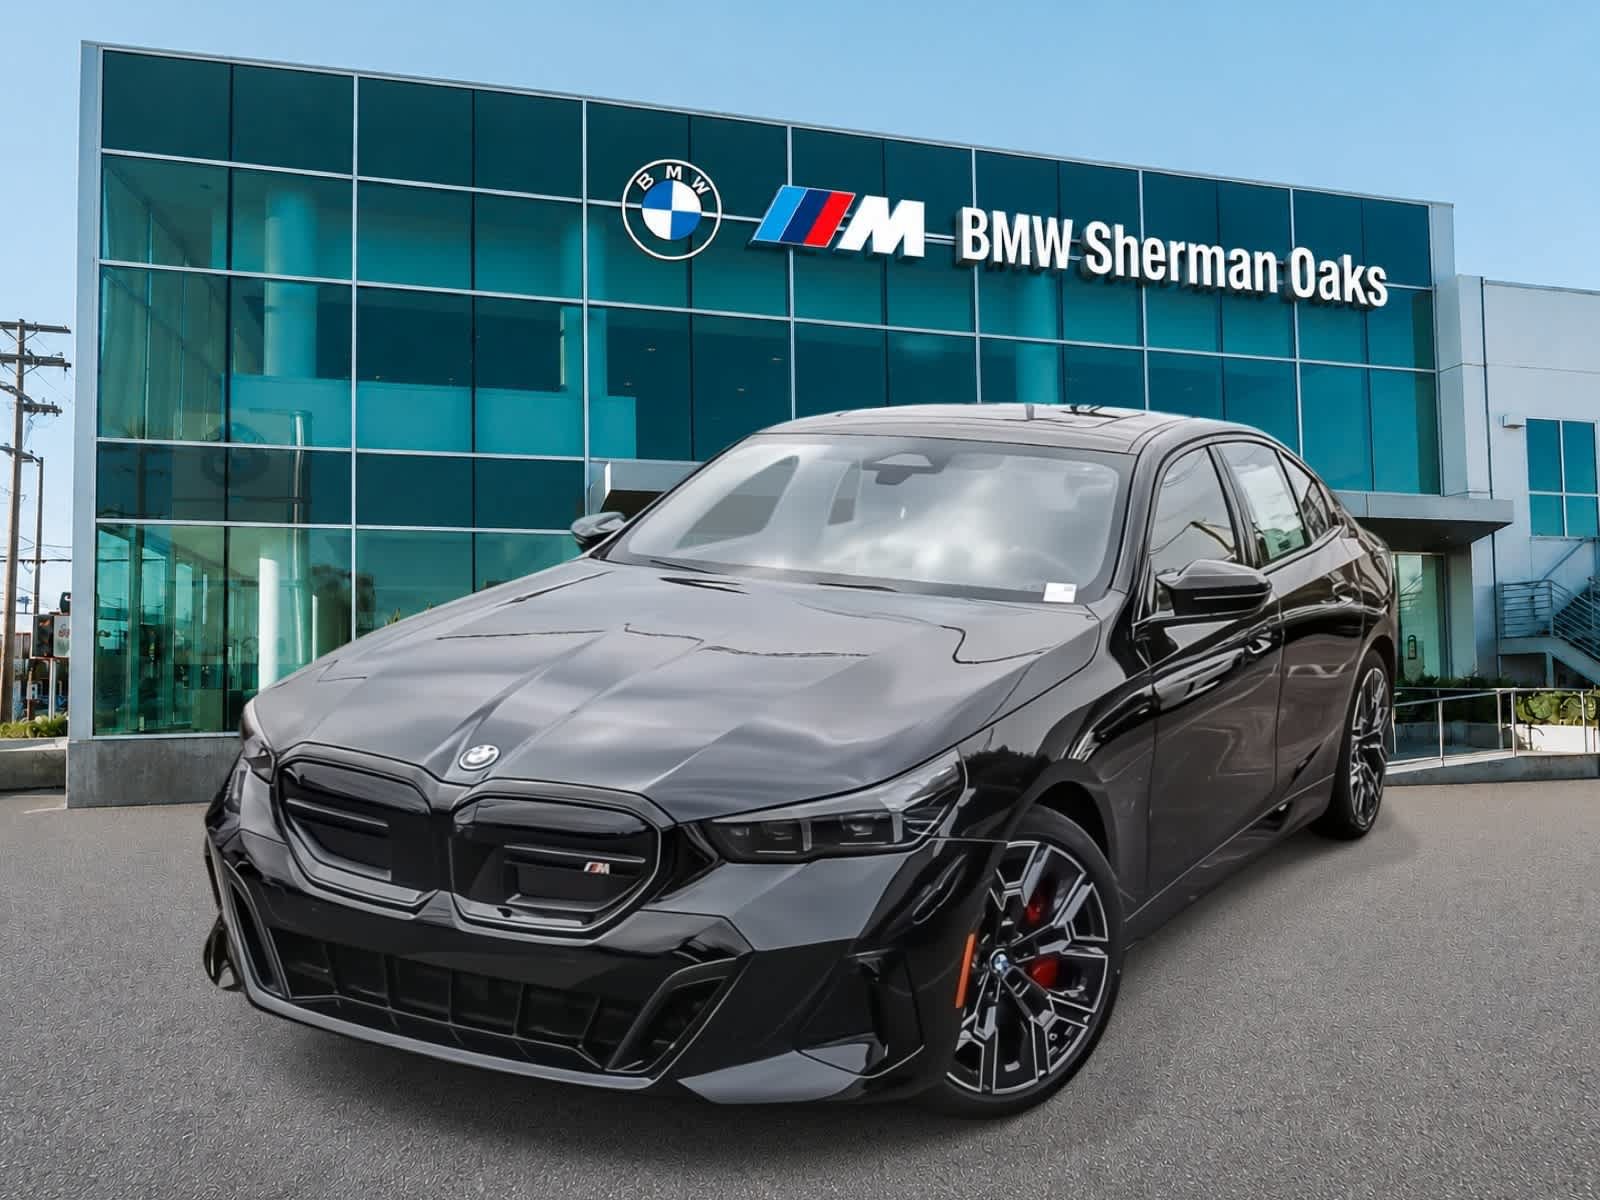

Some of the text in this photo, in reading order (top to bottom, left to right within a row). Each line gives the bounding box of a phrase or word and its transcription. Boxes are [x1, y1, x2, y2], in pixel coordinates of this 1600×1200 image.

[636, 165, 711, 195] BMW
[835, 194, 925, 258] M
[960, 206, 1390, 308] BMW Sherman Oaks
